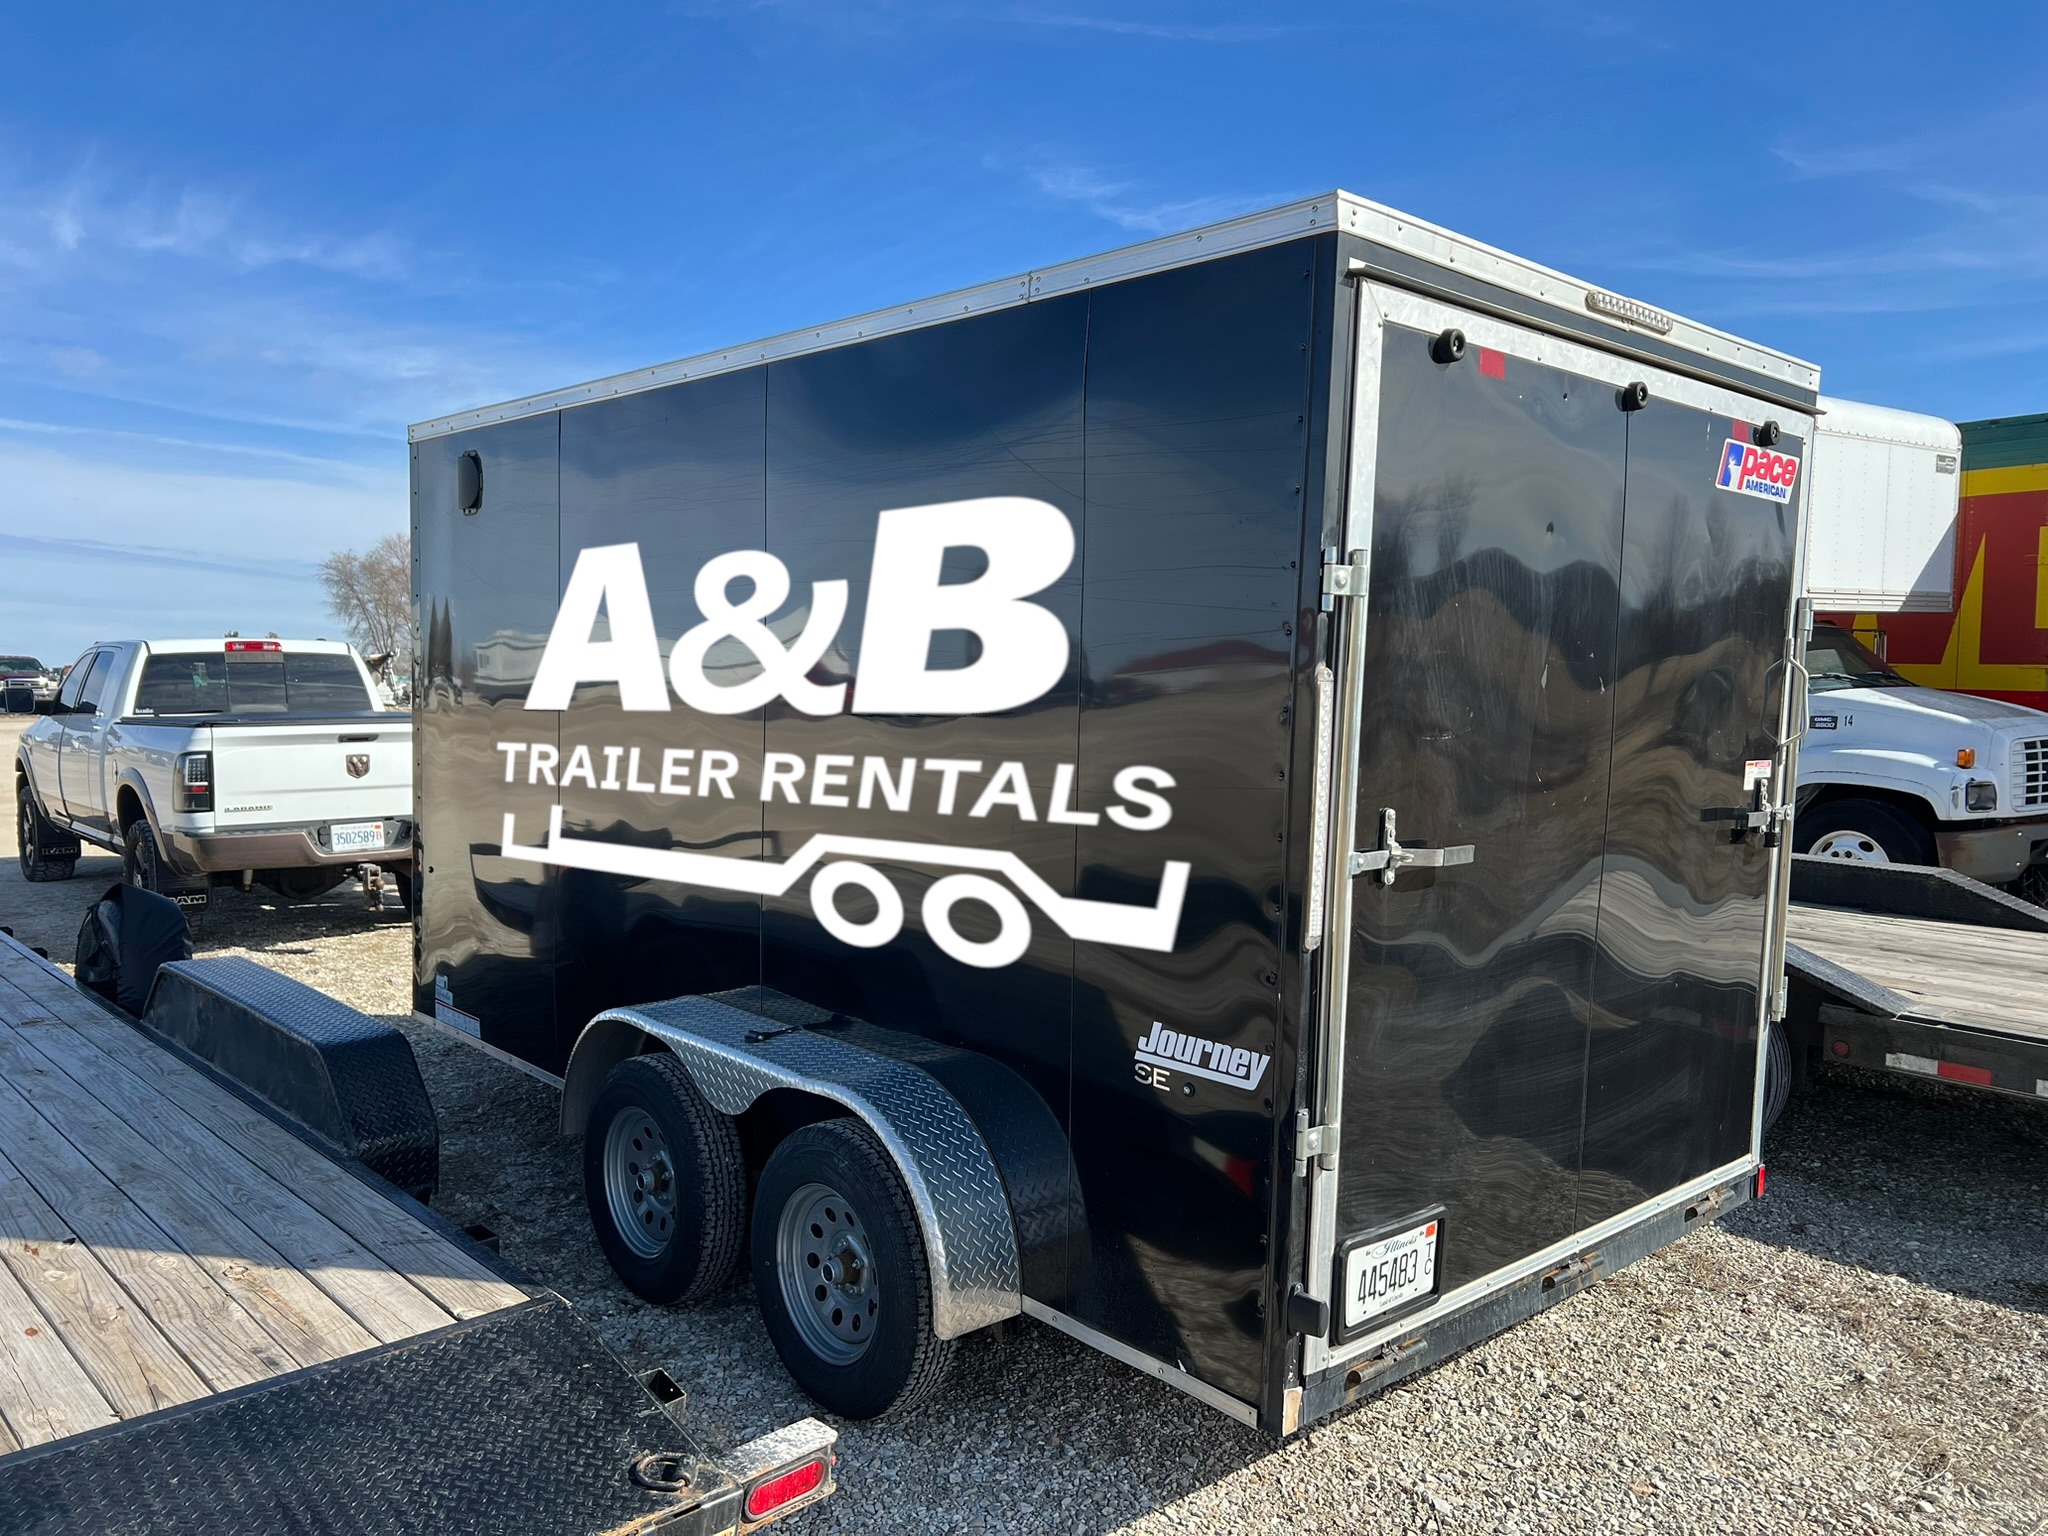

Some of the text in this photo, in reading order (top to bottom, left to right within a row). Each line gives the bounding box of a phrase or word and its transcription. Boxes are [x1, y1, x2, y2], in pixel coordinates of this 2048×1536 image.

[1737, 447, 1797, 490] pace
[1745, 479, 1787, 498] AMERICAN
[523, 496, 1076, 716] A&B
[1844, 715, 1853, 727] 14
[496, 742, 1177, 831] TRAILER RENTALS
[334, 830, 375, 845] 3502589
[1135, 1021, 1271, 1091] Journey
[1134, 1063, 1170, 1092] SE
[1371, 1234, 1418, 1259] Illinois
[1358, 1249, 1418, 1305] 445483
